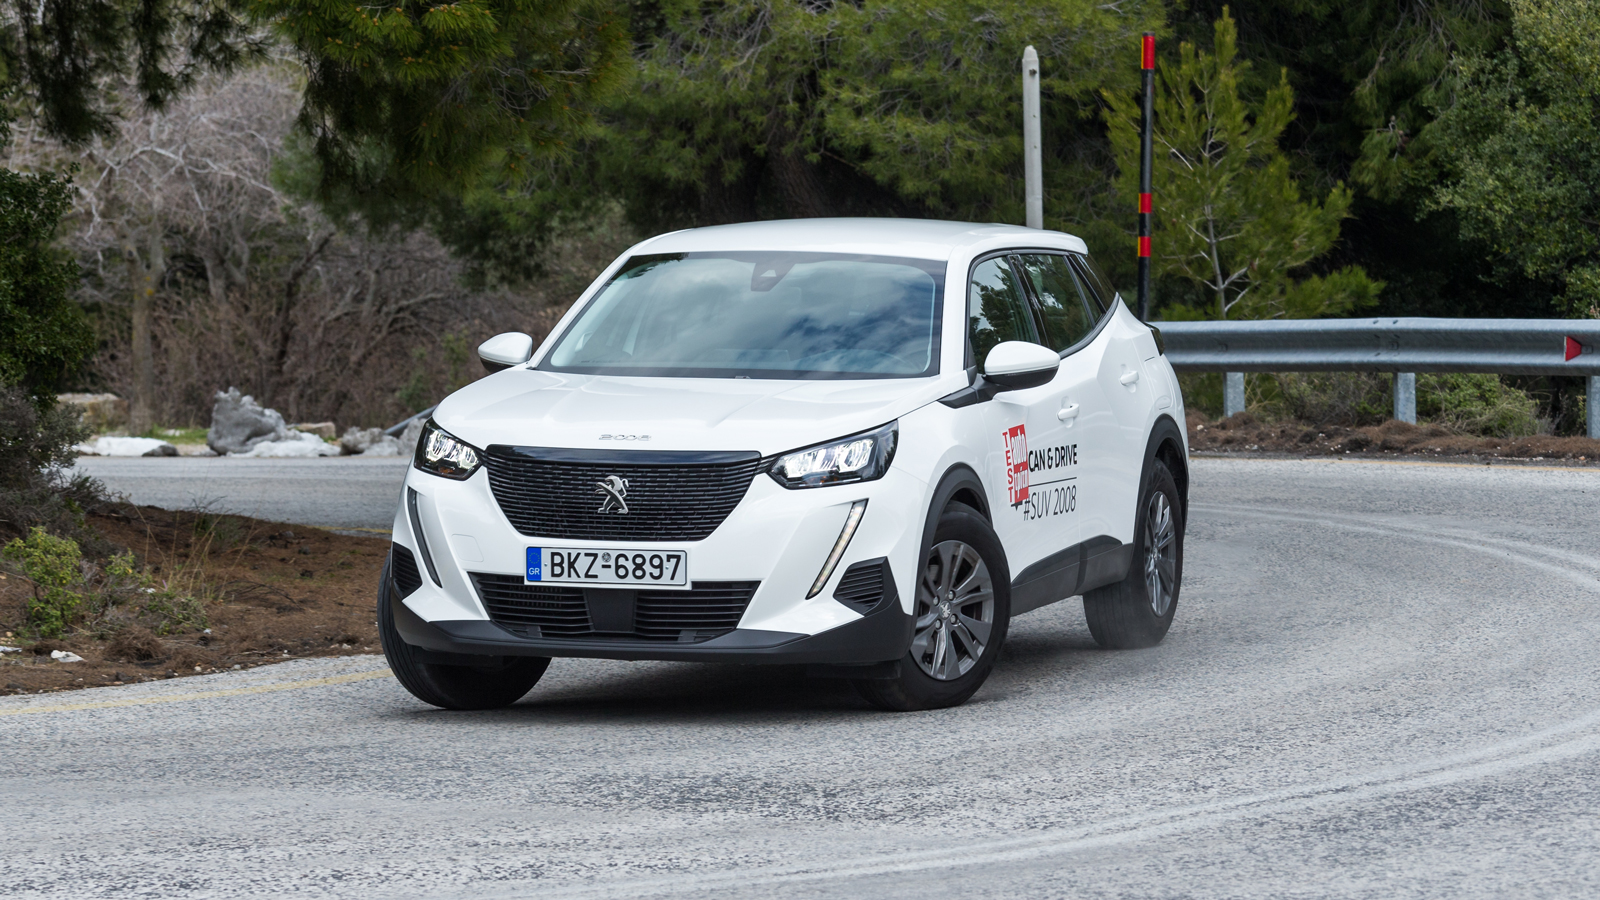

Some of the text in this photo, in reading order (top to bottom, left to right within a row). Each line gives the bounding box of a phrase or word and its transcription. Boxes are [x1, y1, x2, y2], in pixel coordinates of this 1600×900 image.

[1002, 431, 1014, 503] TEST
[1028, 443, 1078, 473] CAN & DRIVE
[1023, 484, 1077, 521] #SUV 2008
[528, 567, 540, 576] GR
